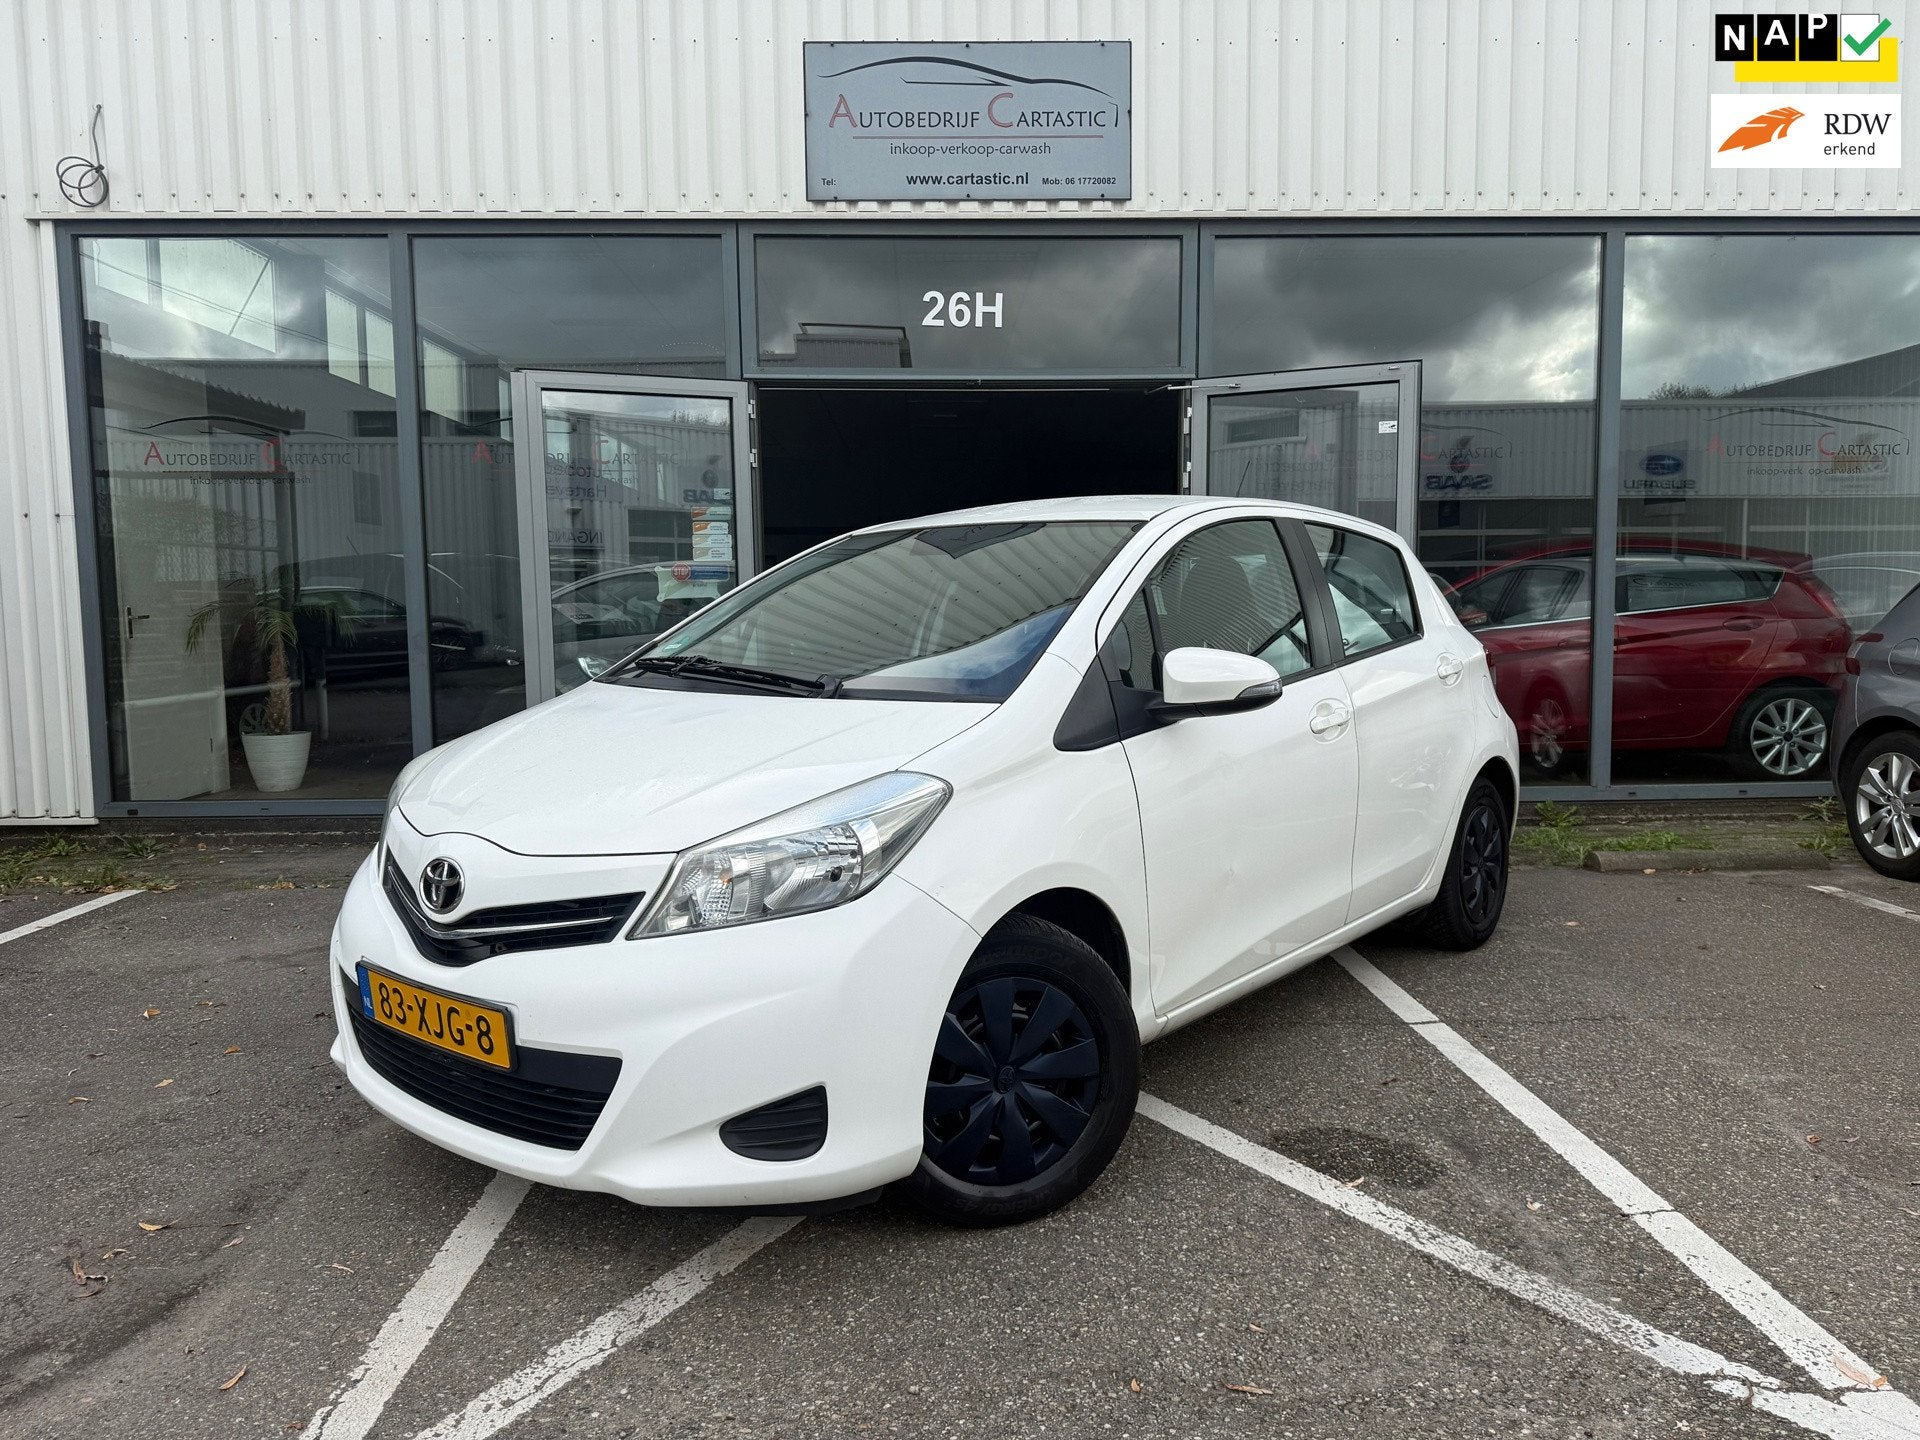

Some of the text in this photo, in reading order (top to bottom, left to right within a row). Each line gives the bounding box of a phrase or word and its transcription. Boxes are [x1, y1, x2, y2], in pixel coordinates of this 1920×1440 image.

[828, 92, 1106, 128] AUTOBEDRIJF CARTASTIC
[890, 142, 1051, 157] inkoop-verkoop-carwash
[821, 178, 836, 186] Tel:
[906, 172, 1029, 186] www.cartastic.nl
[1042, 177, 1116, 185] Mob: 06 17720082
[922, 290, 1003, 328] 26H
[144, 441, 257, 466] AUTOBEDRIJF
[1706, 432, 1900, 457] AUTOBEDRIJF CARTASTIC
[379, 982, 494, 1055] 83-XJG-8
